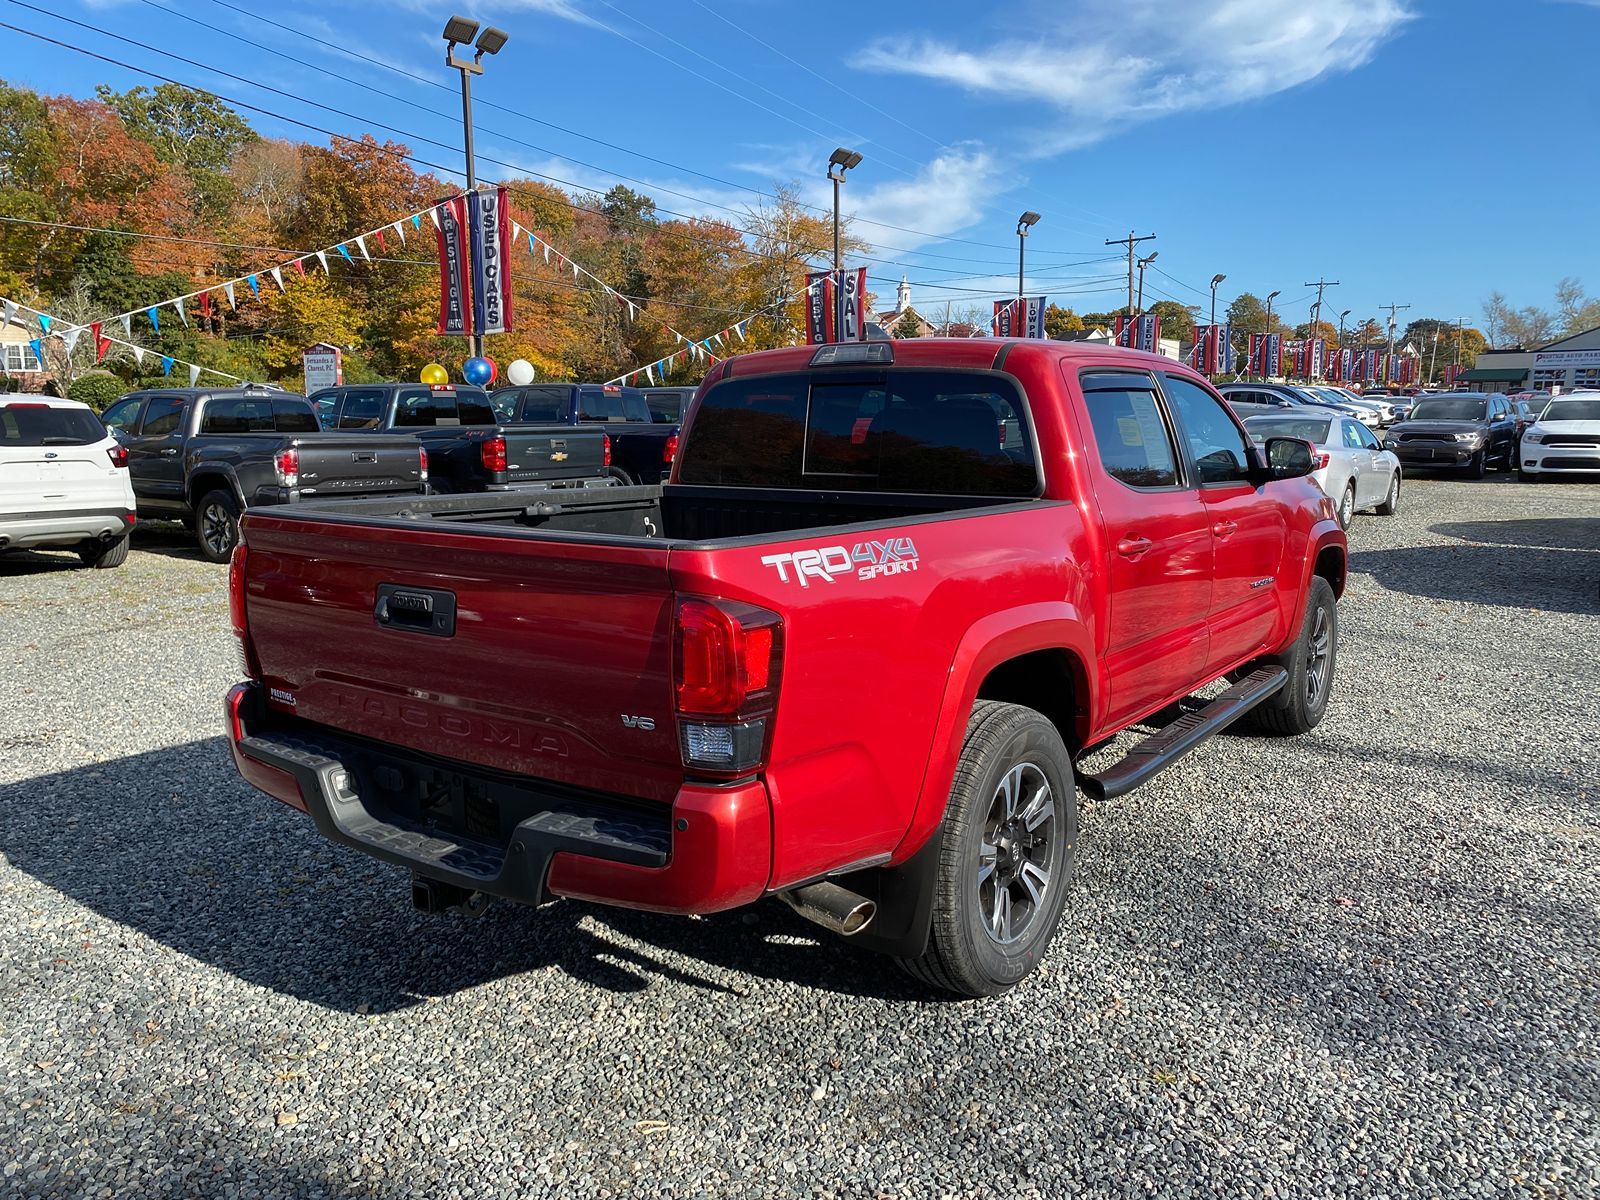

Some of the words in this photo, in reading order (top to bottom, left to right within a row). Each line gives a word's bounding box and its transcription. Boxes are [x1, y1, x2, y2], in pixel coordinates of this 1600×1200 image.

[481, 198, 497, 258] USED
[440, 204, 459, 312] PRESTIGE
[485, 264, 500, 324] CARS
[1028, 302, 1037, 322] LOW
[1145, 318, 1153, 338] USED
[1218, 329, 1226, 368] SUV
[760, 545, 855, 589] TRD
[858, 558, 920, 581] SPORT
[338, 694, 569, 758] TACOMA
[620, 713, 656, 731] V6
